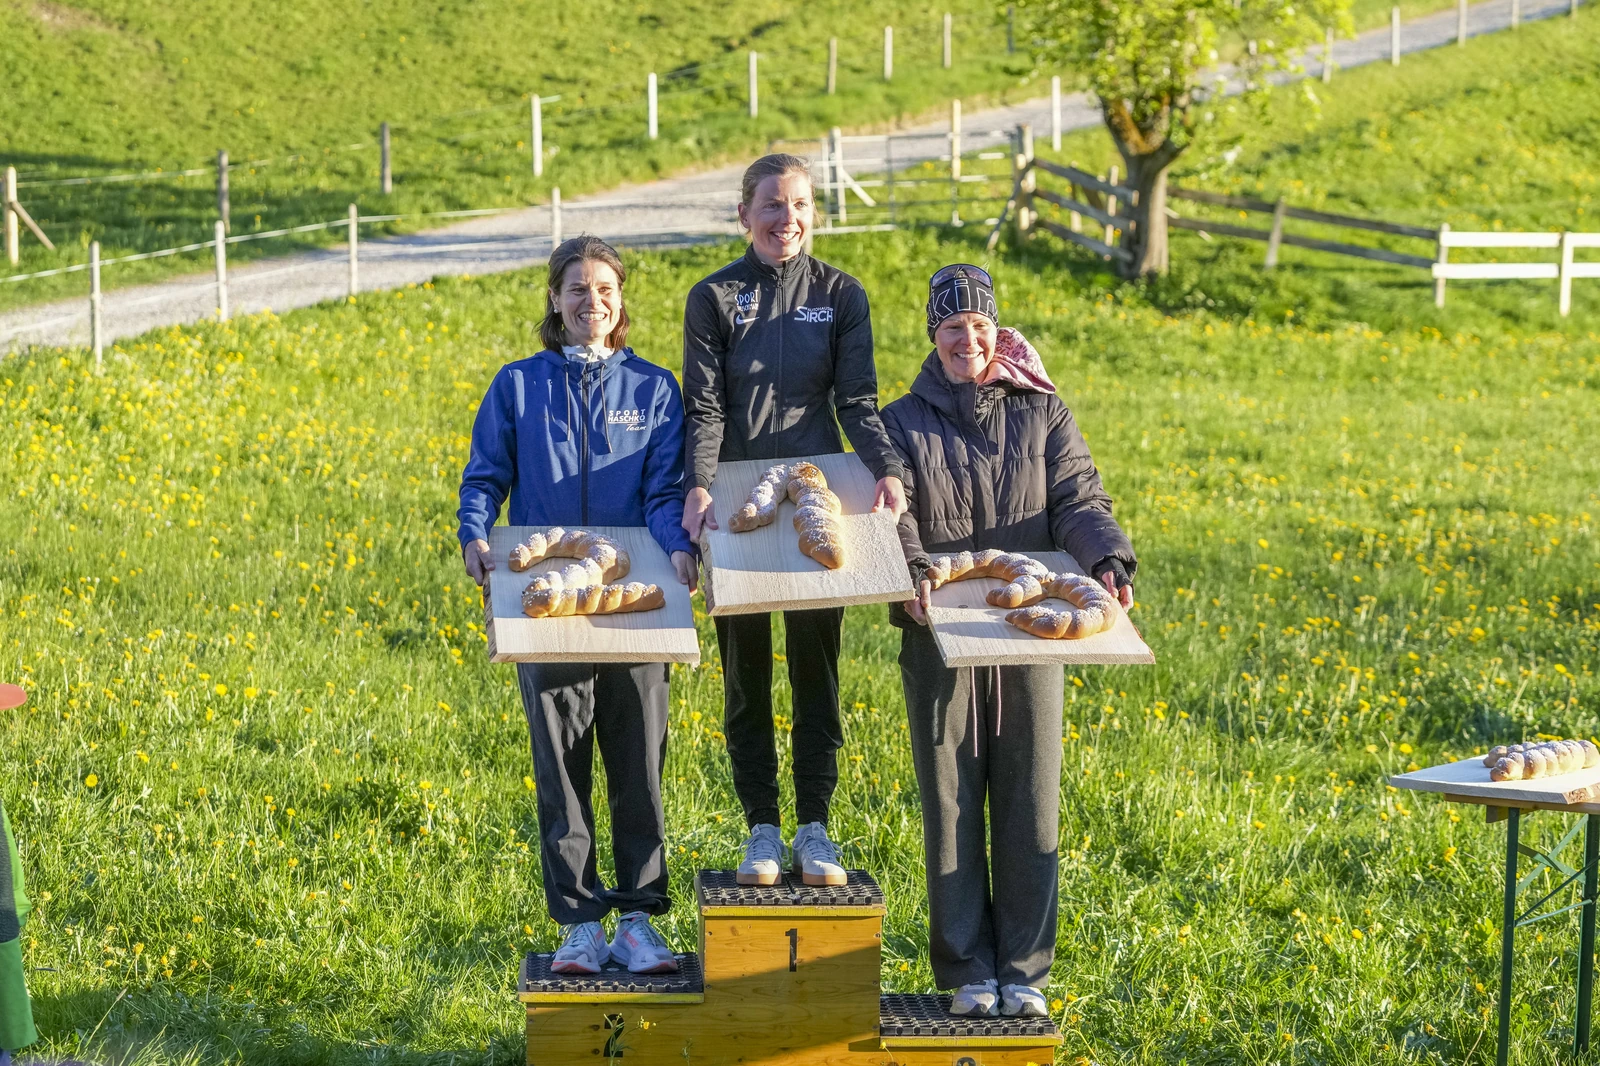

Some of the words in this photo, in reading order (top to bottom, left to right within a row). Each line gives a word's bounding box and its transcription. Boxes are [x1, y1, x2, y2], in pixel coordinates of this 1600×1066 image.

[734, 290, 758, 305] SPORT
[794, 306, 834, 322] SIRCH
[626, 424, 646, 432] Team
[784, 928, 798, 972] 1
[603, 1013, 625, 1058] 2
